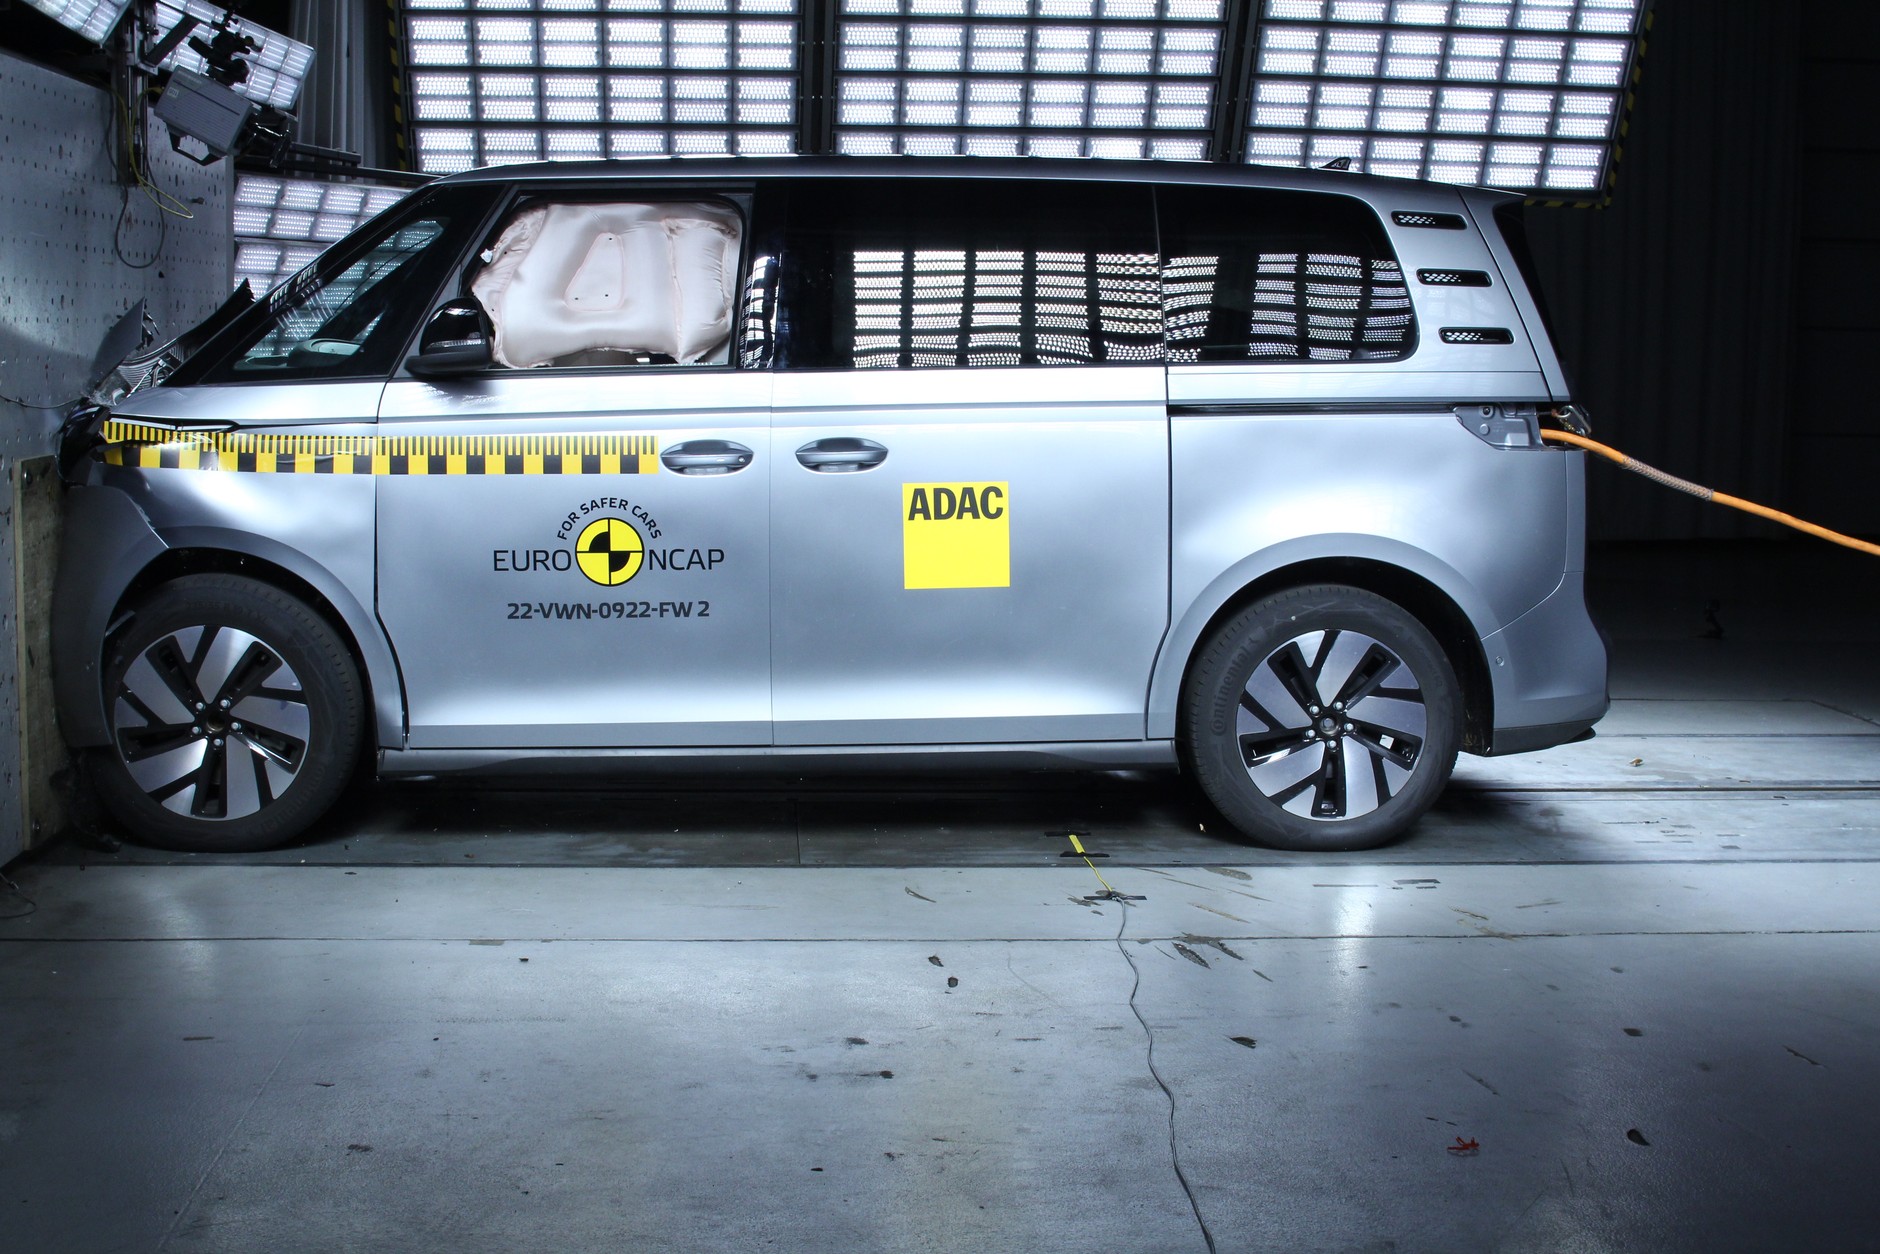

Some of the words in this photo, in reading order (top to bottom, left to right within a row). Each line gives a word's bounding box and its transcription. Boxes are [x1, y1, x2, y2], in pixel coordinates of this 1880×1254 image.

[557, 512, 581, 540] FOR
[580, 497, 629, 515] SAFER
[631, 505, 662, 539] CARS
[908, 486, 1003, 521] ADAC
[493, 549, 572, 571] EURO
[649, 548, 725, 570] NCAP
[507, 601, 693, 619] 22-VWN-0922-FW
[697, 601, 710, 617] 2
[1210, 645, 1252, 736] Continental
